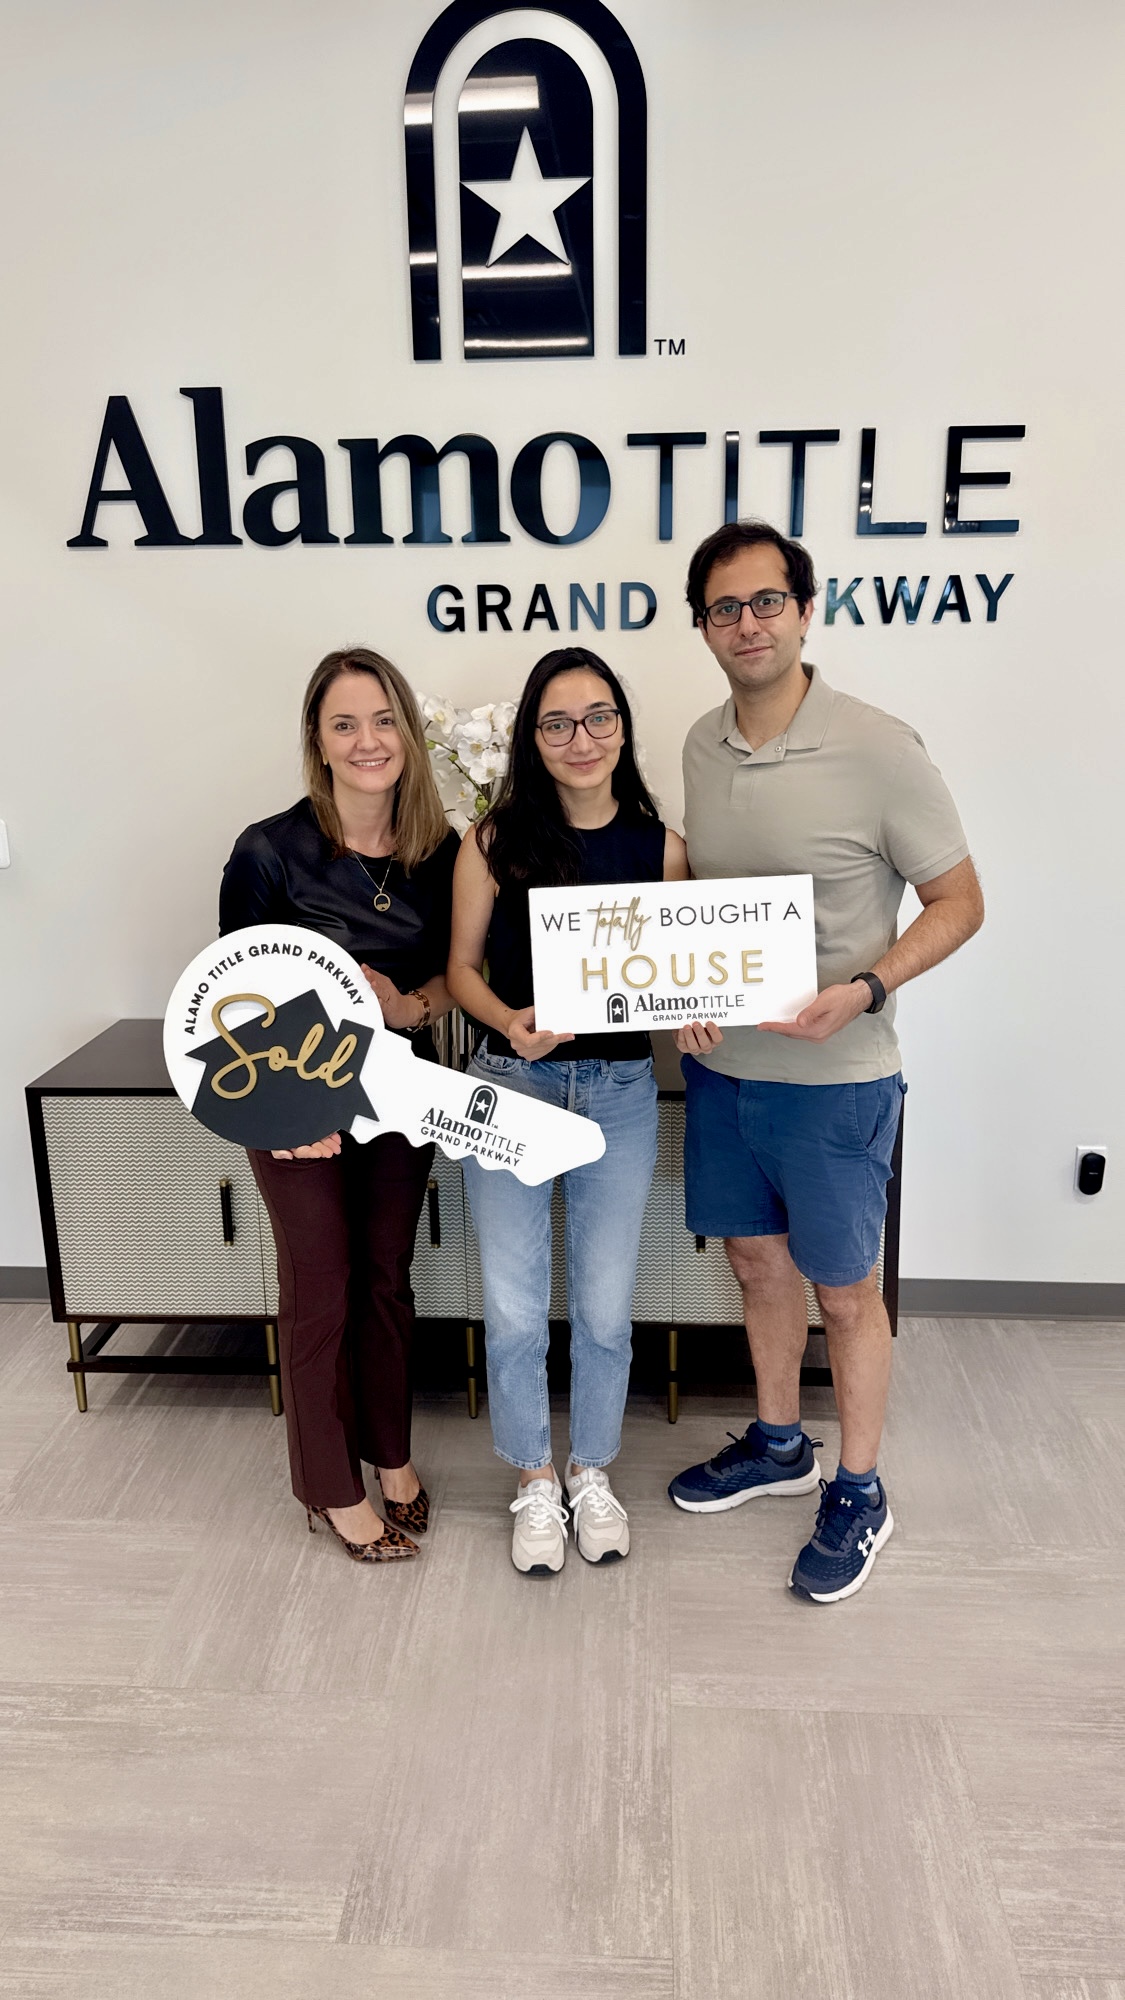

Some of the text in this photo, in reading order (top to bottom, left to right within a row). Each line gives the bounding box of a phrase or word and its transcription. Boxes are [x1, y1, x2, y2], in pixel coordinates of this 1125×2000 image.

[654, 339, 685, 355] TM
[66, 386, 1026, 548] Alamo TITLE
[427, 582, 657, 632] GRAND
[541, 896, 801, 951] WE totally BOUGHT A
[184, 943, 364, 1035] ALAMO TITLE GRAND PARKWAY
[581, 950, 764, 991] HOUSE
[634, 993, 745, 1012] Alamo TITLE
[652, 1011, 729, 1021] GRAND PARKWAY
[211, 993, 358, 1100] Sold
[420, 1126, 521, 1167] GRAND PARKWAY
[421, 1107, 527, 1156] Alamo TITLE
